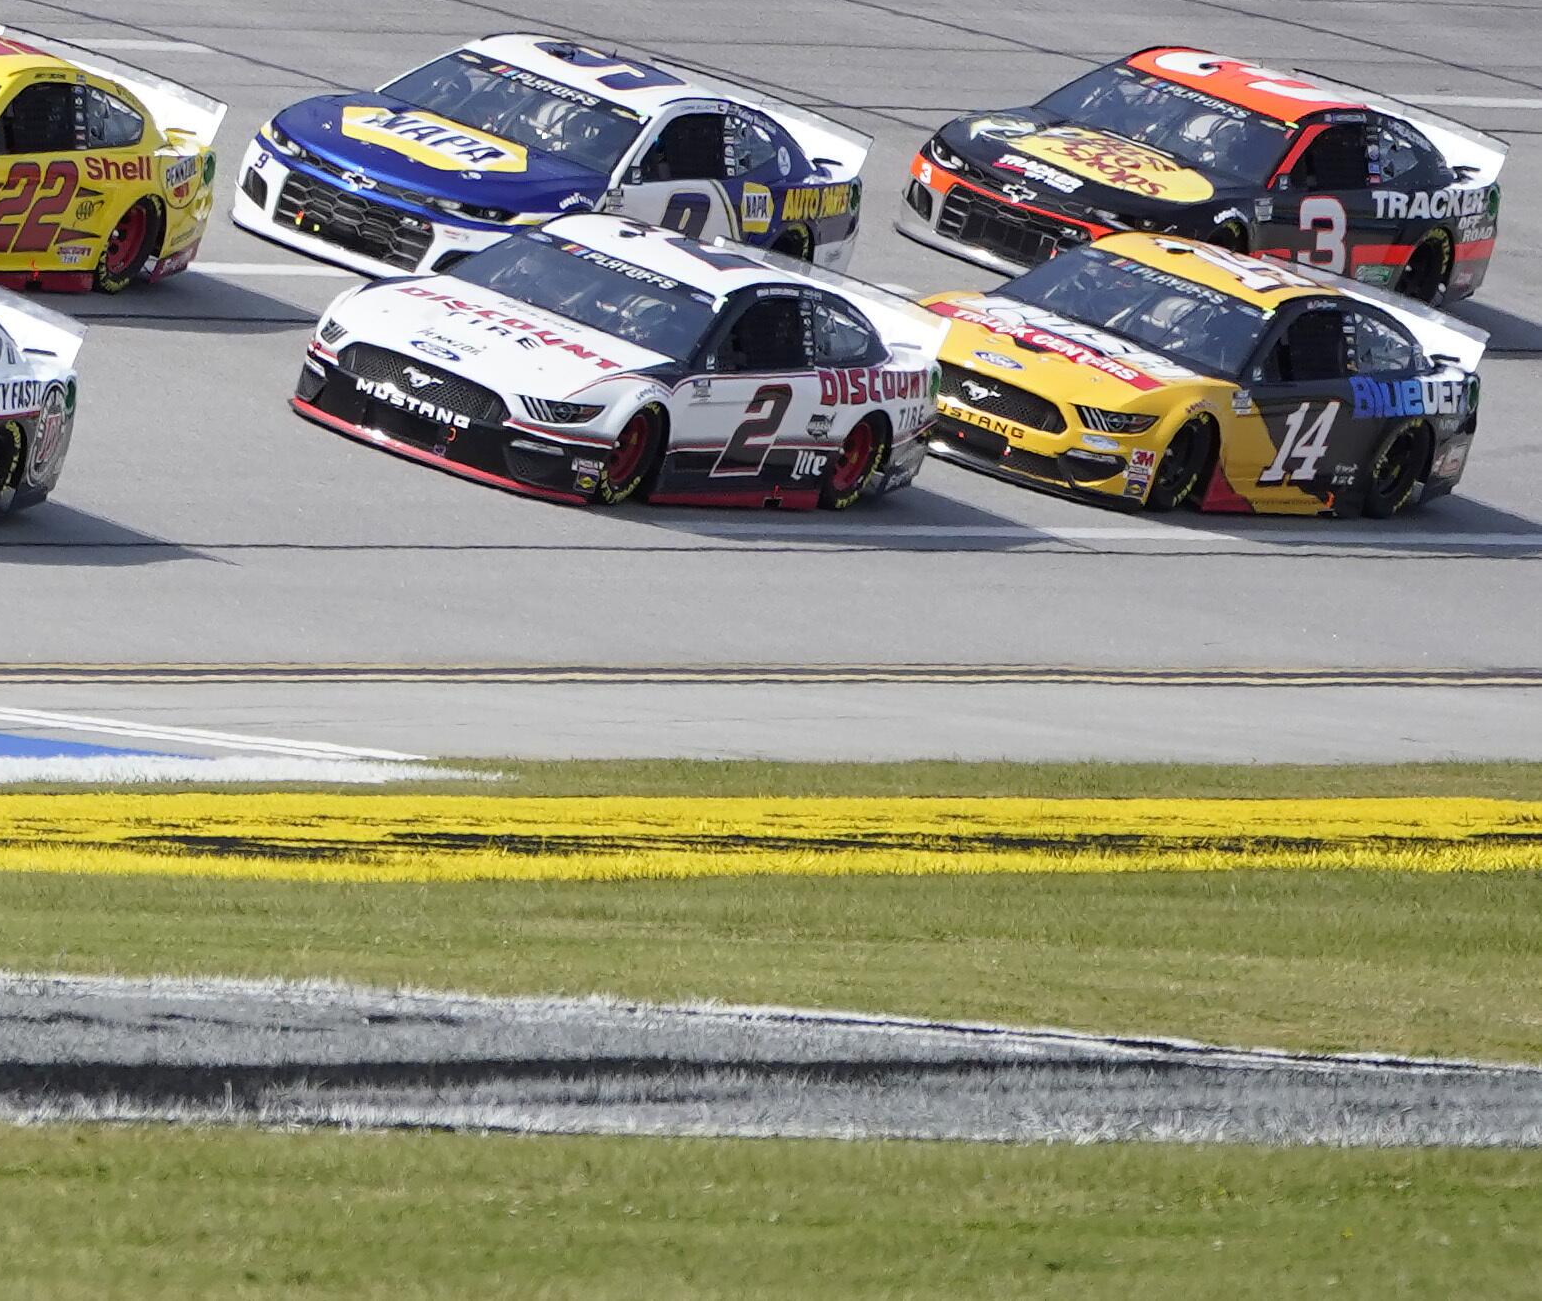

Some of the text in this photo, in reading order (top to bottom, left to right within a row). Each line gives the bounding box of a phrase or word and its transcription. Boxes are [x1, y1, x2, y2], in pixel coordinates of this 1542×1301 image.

[513, 73, 601, 106] PLAYOFFS
[1163, 85, 1252, 119] PLAYOFFS
[363, 114, 508, 164] NAPA
[84, 156, 152, 181] Shell
[919, 162, 933, 185] 3
[781, 187, 821, 221] AUTO
[1371, 186, 1486, 220] TRACKER
[1299, 195, 1347, 275] 3
[1458, 216, 1481, 230] OFF
[1462, 227, 1493, 243] ROAD
[585, 254, 679, 290] PLAYOFFS
[1132, 267, 1229, 305] PLAYOFFS
[395, 287, 624, 371] DISCOUNT
[954, 309, 1139, 381] TRUCK CENTERS
[355, 377, 472, 429] MUSTANG
[817, 368, 929, 407] DISCOUNT
[709, 383, 793, 478] 2
[898, 405, 925, 430] TIRE
[1131, 450, 1155, 467] 3M
[1256, 401, 1342, 485] 14
